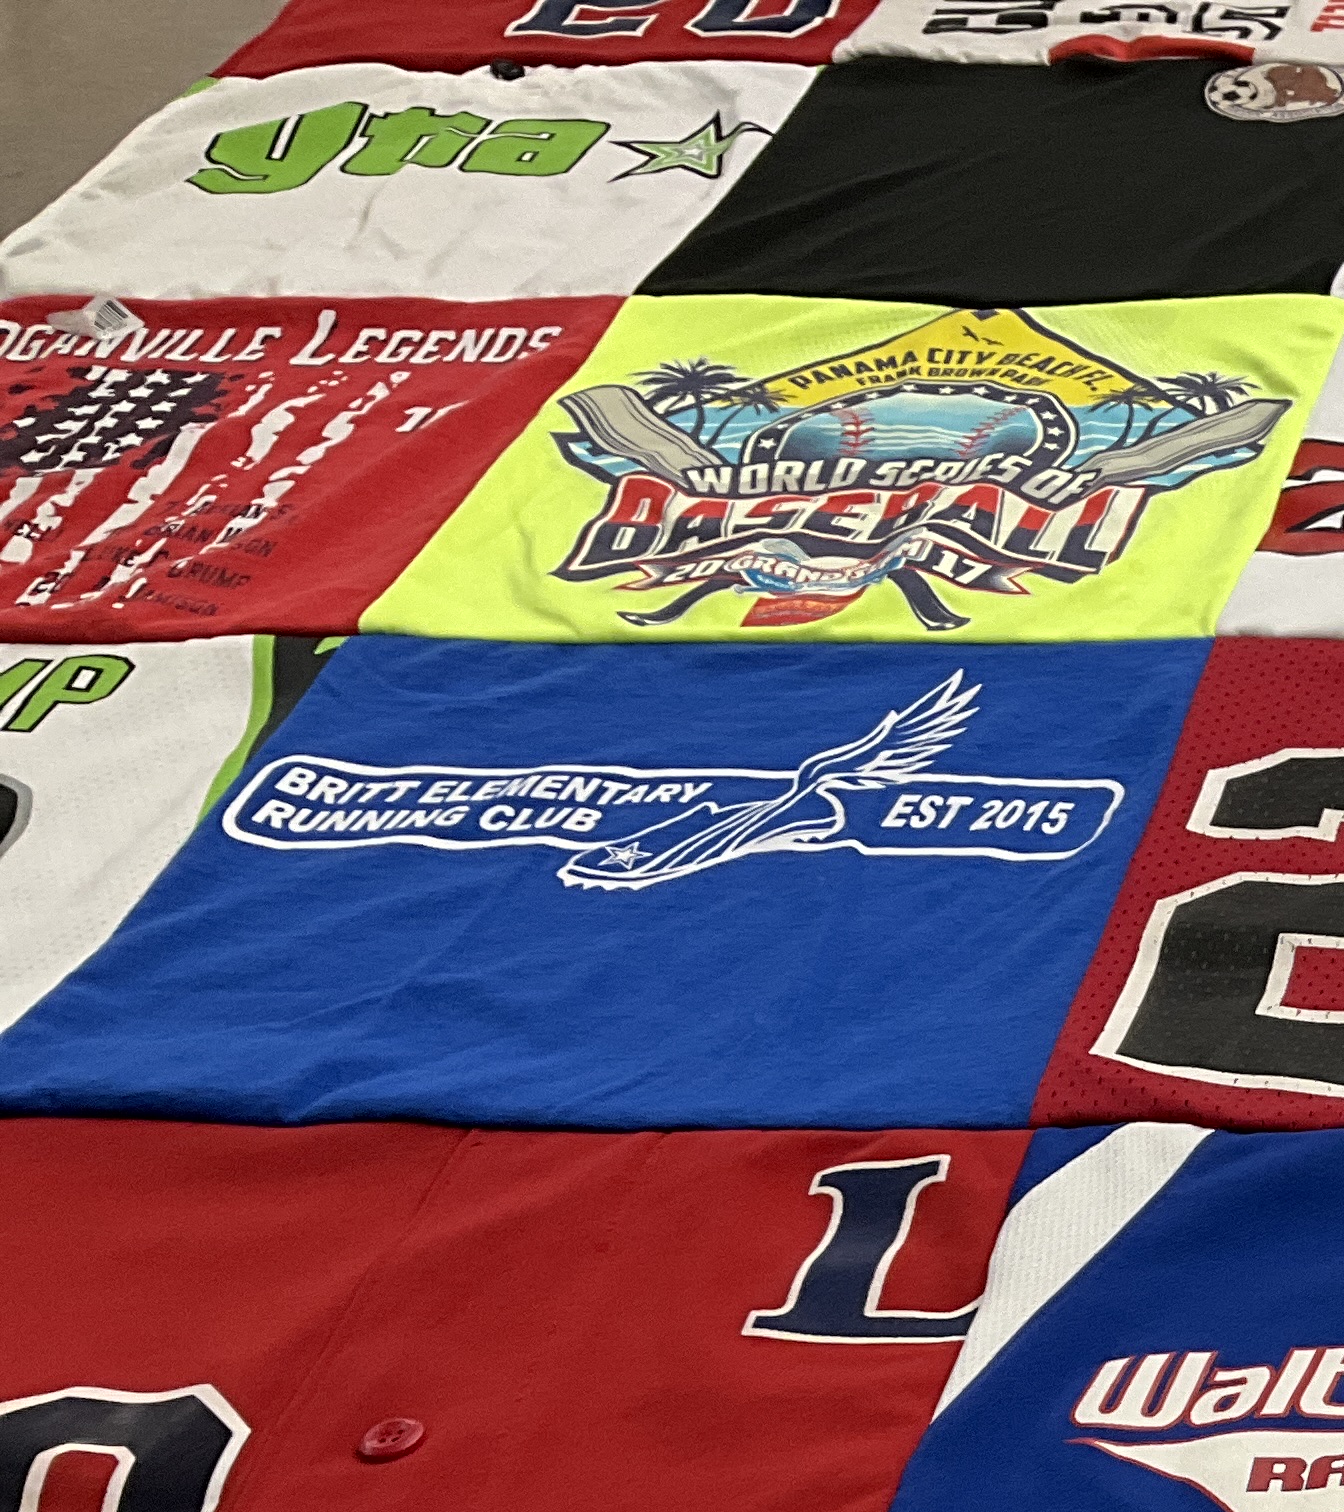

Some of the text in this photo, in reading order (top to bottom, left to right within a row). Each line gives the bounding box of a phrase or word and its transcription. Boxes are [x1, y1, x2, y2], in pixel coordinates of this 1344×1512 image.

[289, 309, 564, 367] LEGENDS
[788, 350, 919, 390] PANAMA
[926, 347, 996, 366] CITY
[998, 352, 1082, 381] BEACH
[855, 365, 922, 387] FRANK
[685, 453, 860, 496] WORLD
[1019, 455, 1103, 505] OF
[570, 475, 1152, 577] BASEBALL
[664, 560, 718, 583] 20
[932, 549, 994, 586] 17
[274, 767, 714, 806] BRITT ELEMENTARY
[252, 800, 606, 834] RUNNING CLUB
[879, 794, 1074, 835] EST 2015
[741, 1153, 984, 1345] L
